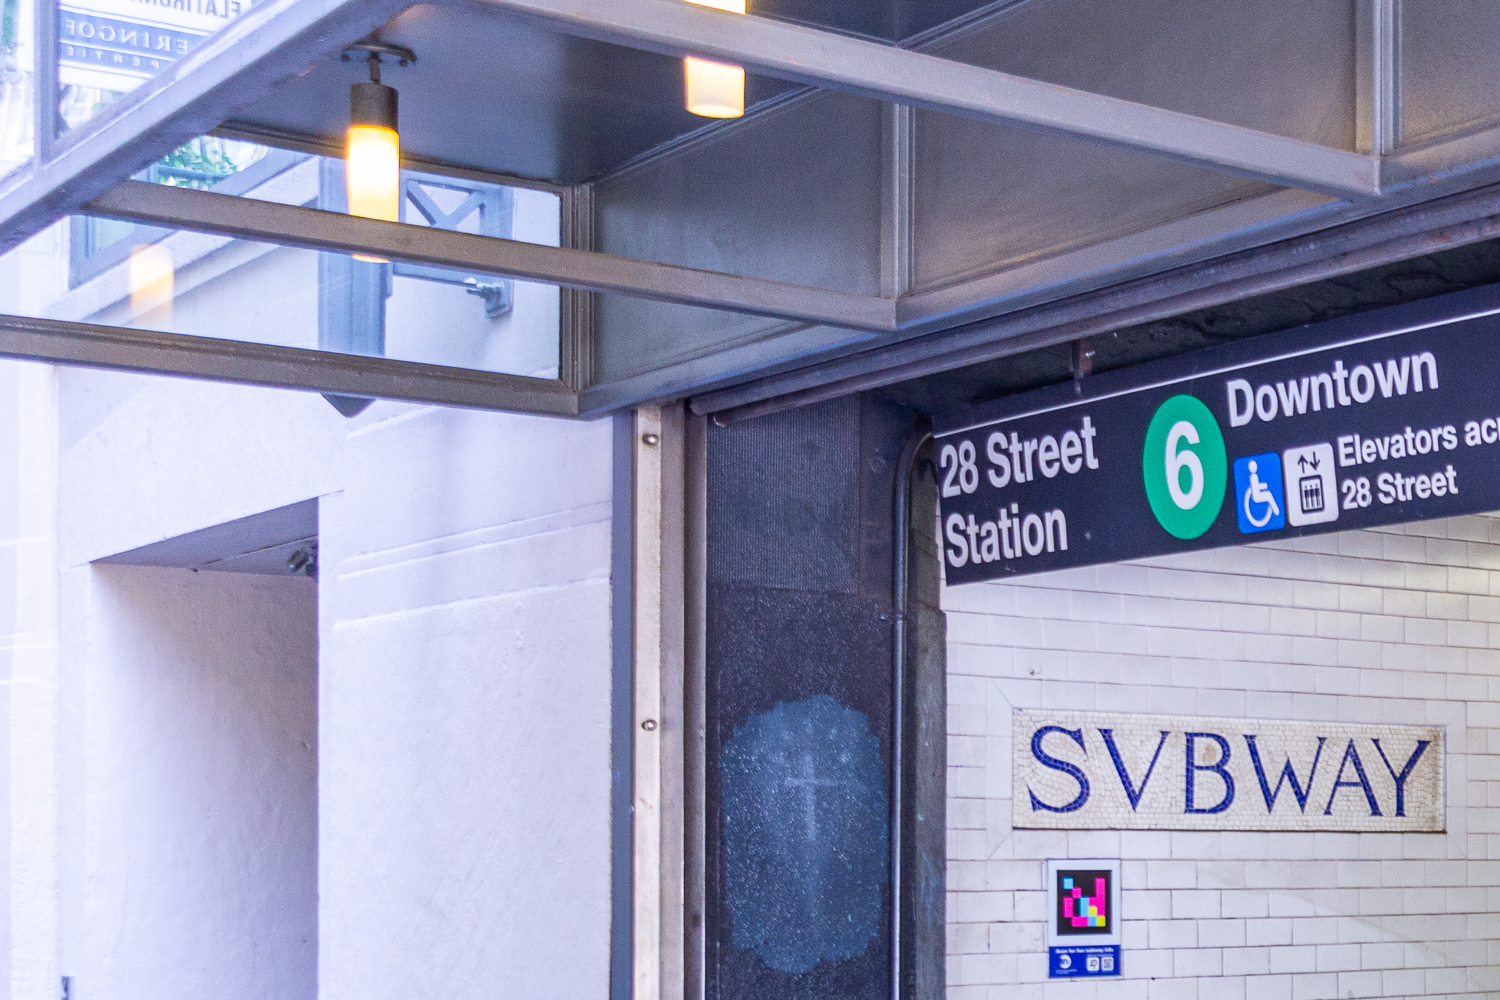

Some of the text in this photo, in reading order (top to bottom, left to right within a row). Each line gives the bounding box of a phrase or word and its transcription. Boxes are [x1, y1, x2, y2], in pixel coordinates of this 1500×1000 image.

[1227, 352, 1439, 427] Downtown
[941, 416, 1099, 498] 28 Street
[1165, 421, 1202, 511] 6
[1339, 424, 1457, 467] Elevators
[1342, 466, 1458, 510] 28 Street
[946, 505, 1068, 567] Station
[1027, 725, 1431, 817] SVBWAY
